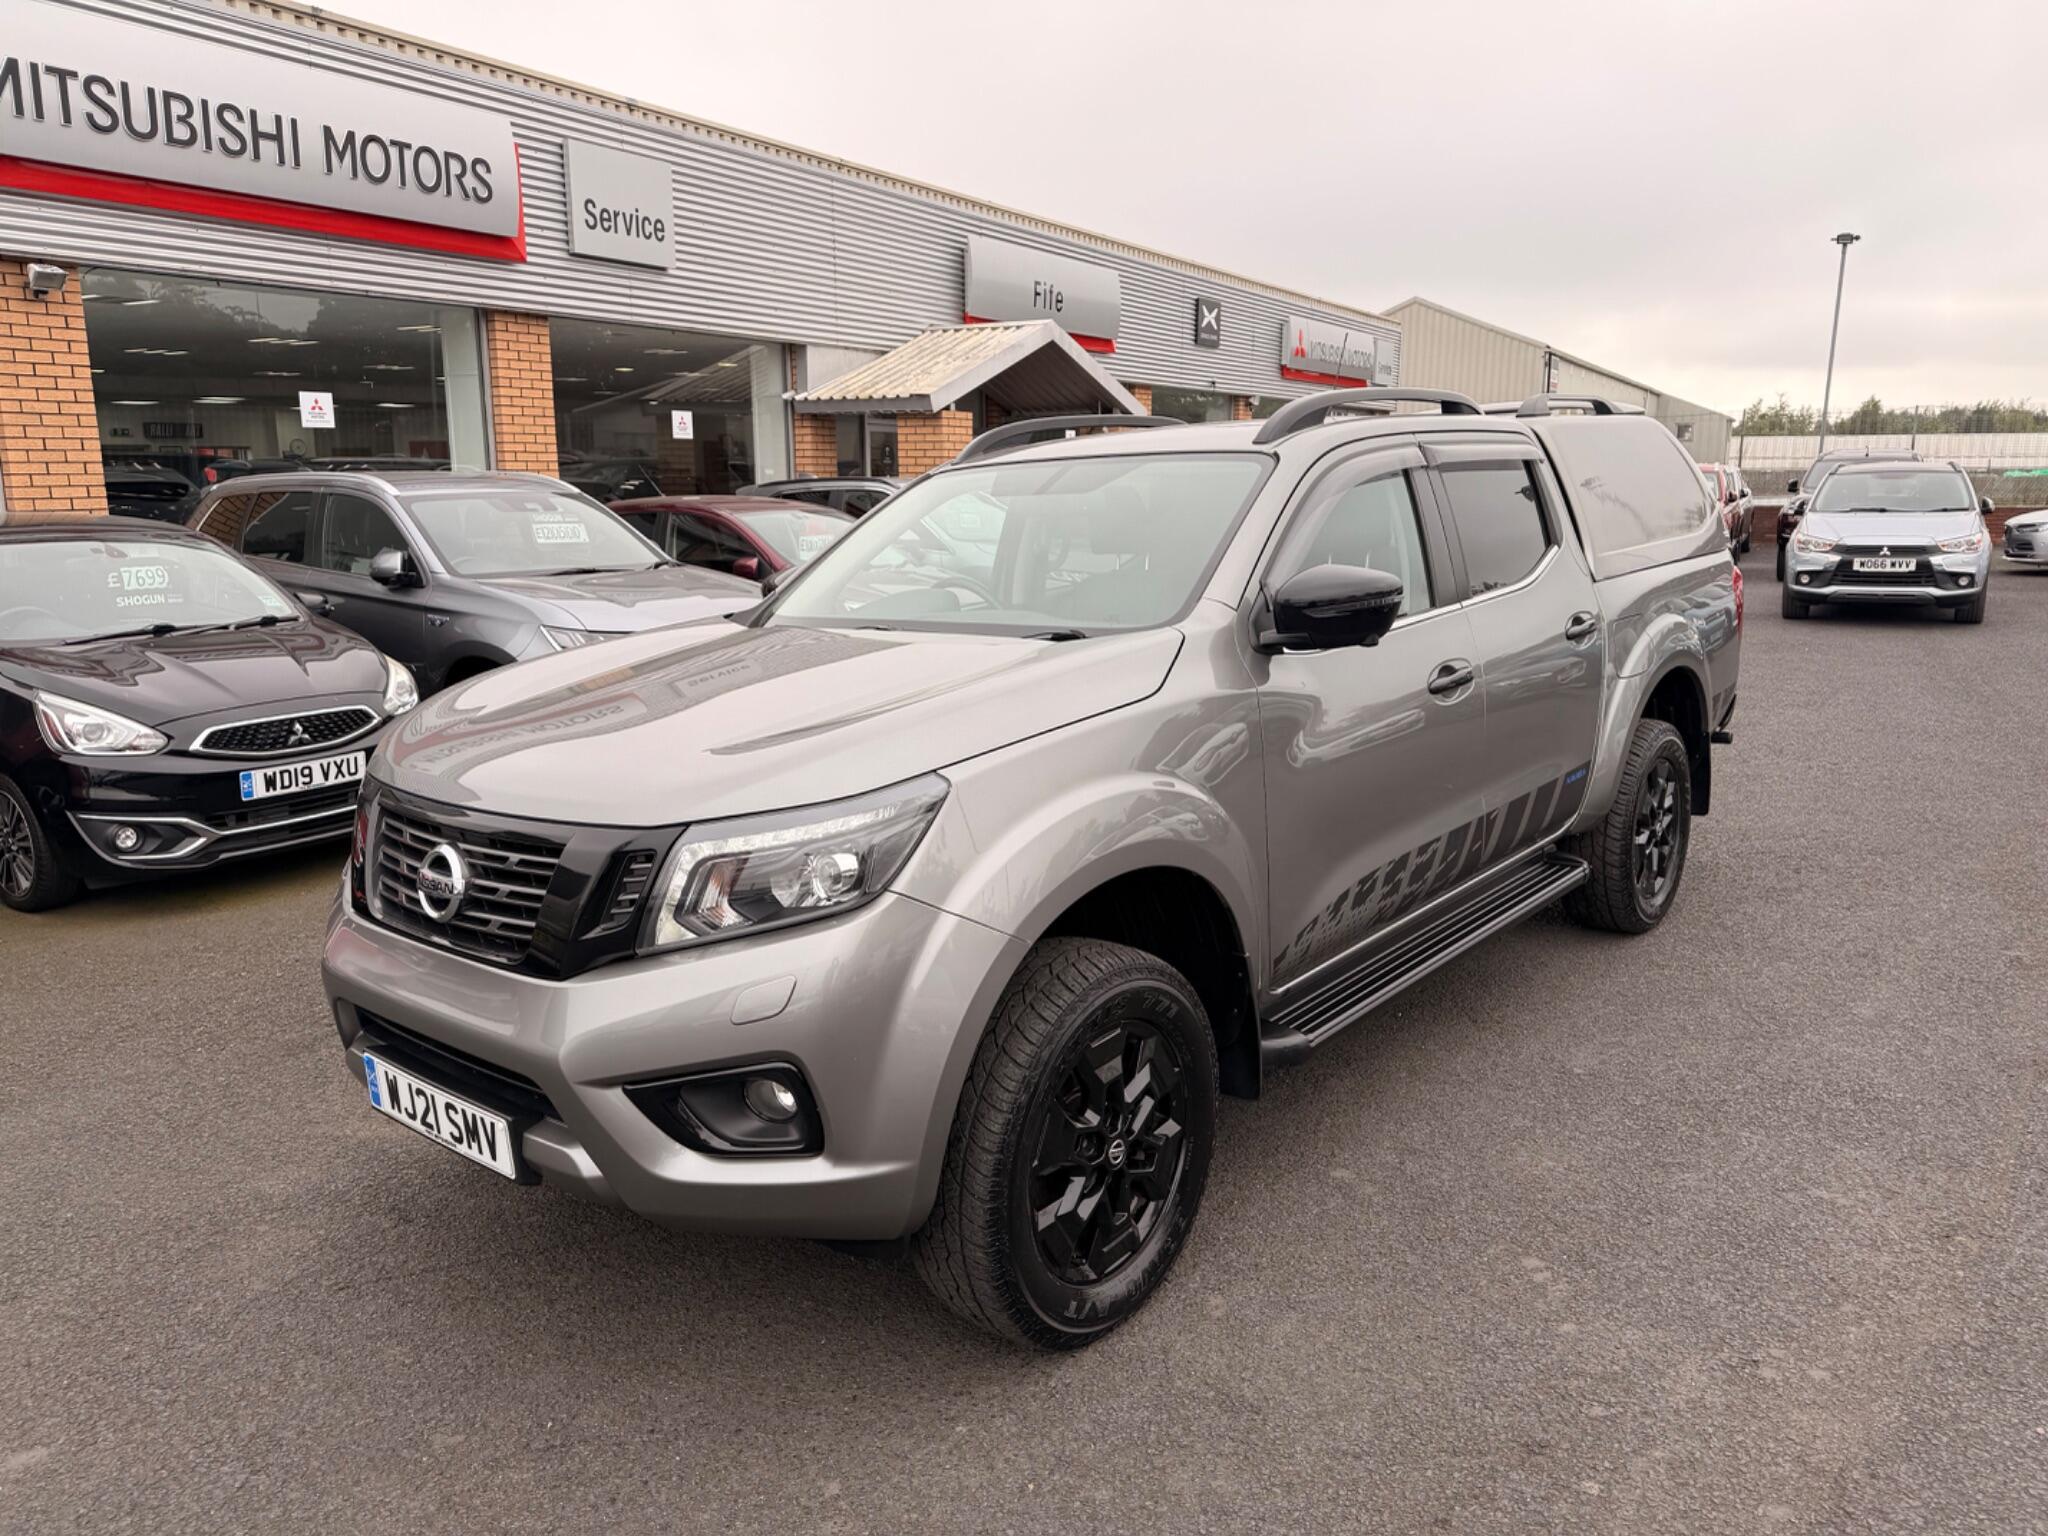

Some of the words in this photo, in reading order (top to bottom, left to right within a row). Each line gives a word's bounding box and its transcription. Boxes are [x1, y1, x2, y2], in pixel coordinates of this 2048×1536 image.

[0, 56, 301, 169] MITSUBISHI
[321, 123, 494, 204] MOTORS
[584, 198, 666, 242] Service
[1033, 280, 1064, 313] Fife
[185, 423, 201, 437] AT
[107, 566, 168, 589] £7699
[116, 593, 166, 608] SHOGUN
[263, 765, 314, 793] WD19
[320, 756, 358, 782] VXU
[384, 1070, 442, 1136] WJ21
[444, 1101, 497, 1162] SMV
